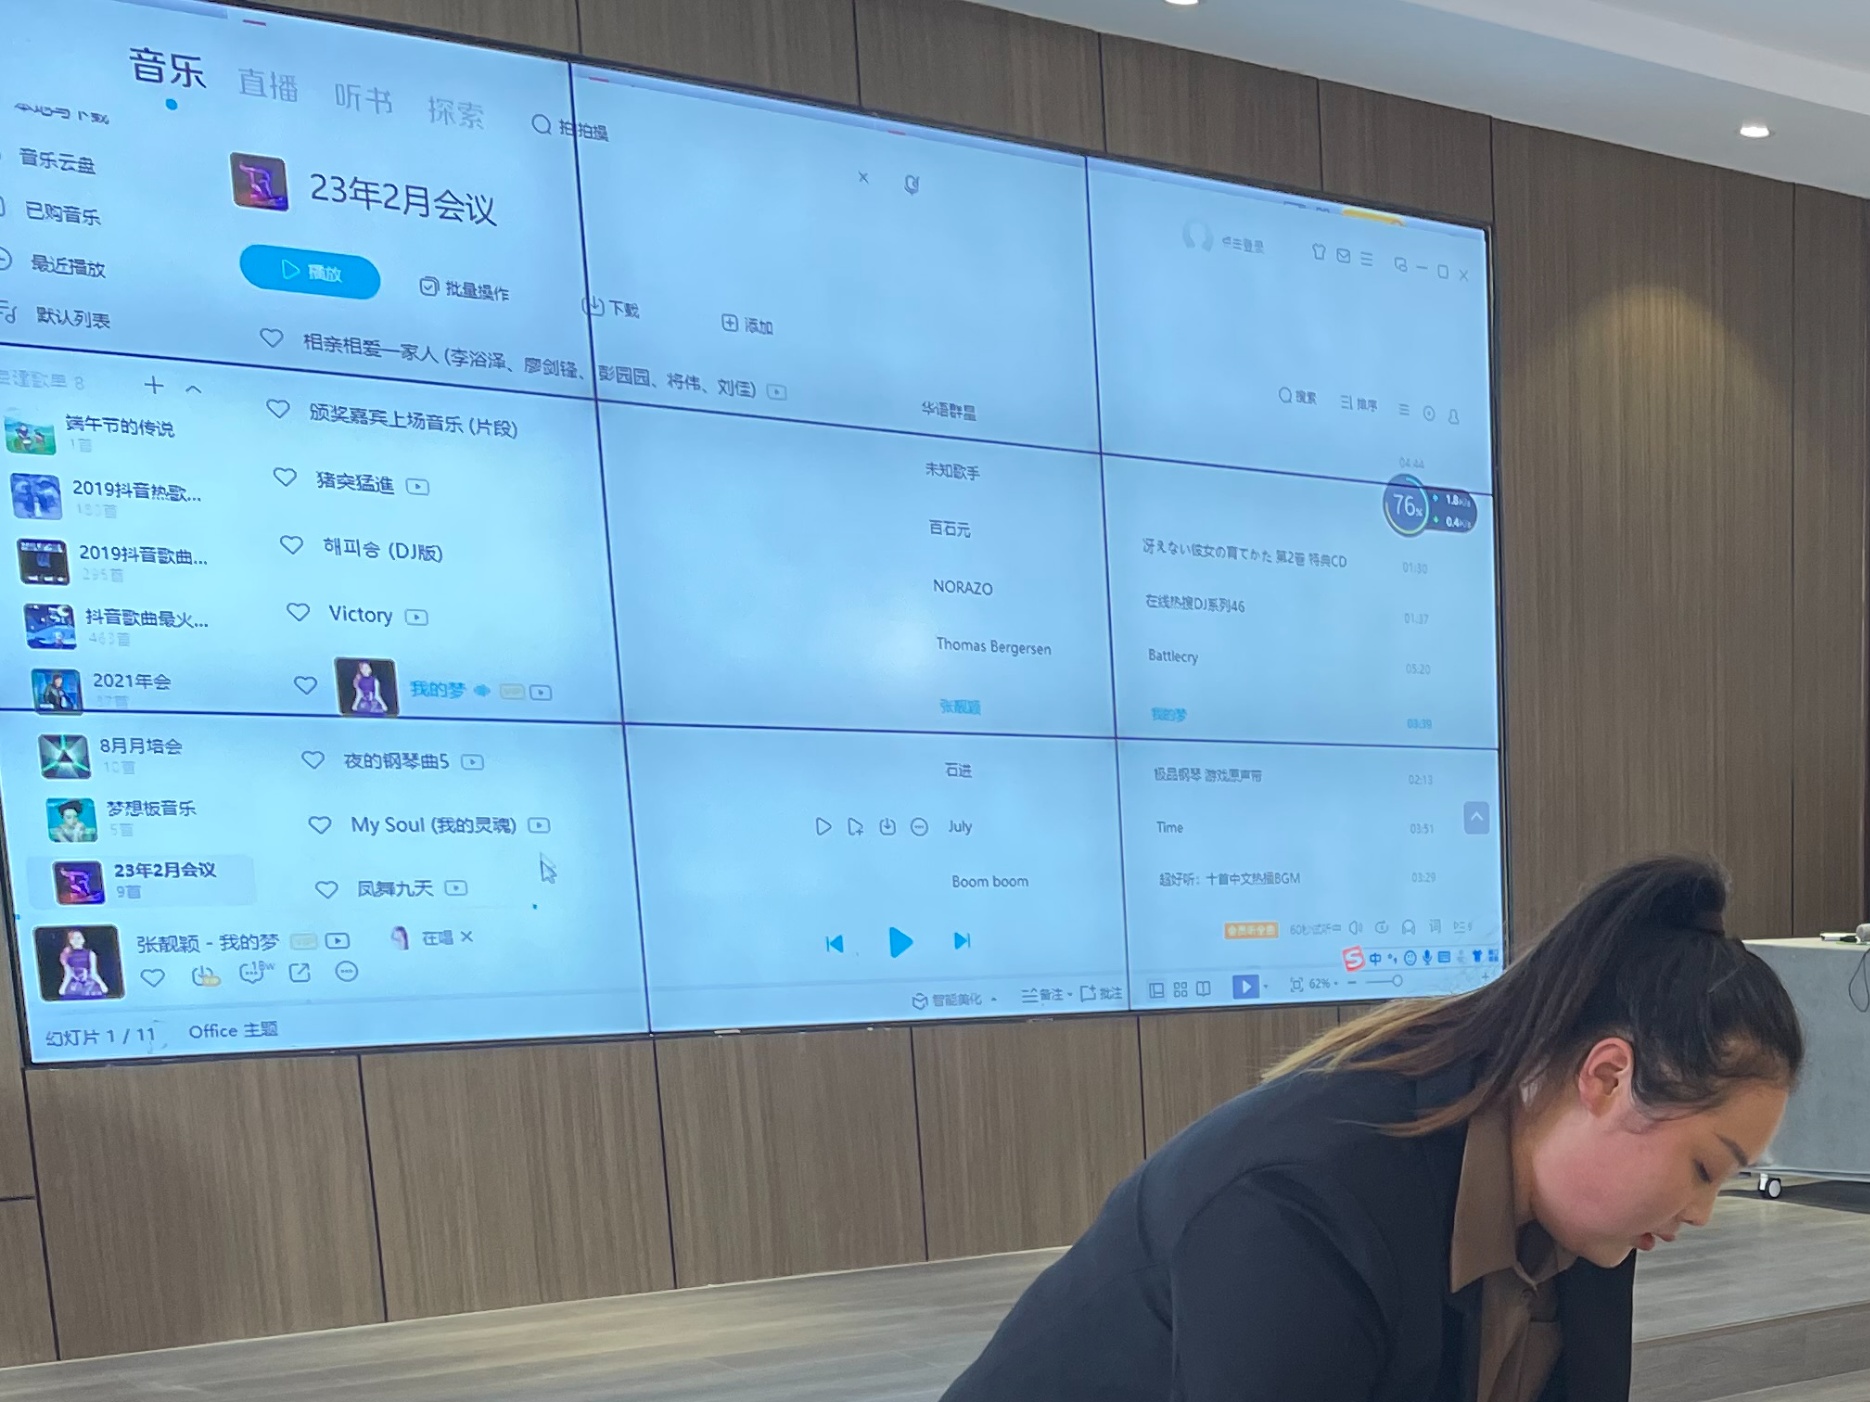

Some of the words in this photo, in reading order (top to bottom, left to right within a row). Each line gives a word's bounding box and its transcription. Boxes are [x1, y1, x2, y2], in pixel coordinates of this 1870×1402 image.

[129, 46, 206, 89] 音乐
[238, 68, 298, 103] 直播
[335, 83, 393, 114] 听书
[428, 96, 485, 130] 探索
[19, 148, 96, 175] 音乐云盘
[310, 173, 497, 226] 23年2月会议
[26, 201, 101, 226] 已购音乐
[31, 254, 106, 278] 最近播放
[308, 264, 342, 283] 播放
[446, 280, 510, 301] 批量操作
[36, 306, 111, 329] 默认列表
[609, 300, 640, 319] 下载
[303, 333, 440, 364] 相亲相爱一家人
[65, 413, 176, 438] 端午节的传说
[310, 403, 465, 434] 颁奖嘉宾上场音乐
[468, 417, 518, 439] (片段)
[925, 461, 981, 481] 未知歌手
[928, 519, 971, 538] 百石元
[323, 537, 380, 559] 해피송
[933, 578, 993, 596] NORAZO
[329, 604, 393, 627] Victory
[936, 636, 987, 654] Thomas
[990, 639, 1052, 658] Bergersen
[1148, 648, 1199, 667] Battlecry
[93, 672, 171, 691] 2021年会
[410, 679, 467, 699] 我的梦
[100, 737, 183, 755] 8月月培会
[344, 751, 450, 770] 夜的钢琴曲5
[107, 800, 197, 817] 梦想板音乐
[351, 816, 380, 836] My
[385, 816, 425, 833] Soul
[431, 816, 517, 835] (我的灵魂)
[949, 819, 973, 836] July
[1156, 820, 1184, 834] Time
[114, 861, 217, 878] 23年2月会议
[358, 879, 434, 898] 凤舞九天
[952, 875, 989, 888] Boom
[992, 874, 1029, 888] boom
[219, 933, 280, 952] 我的梦
[1309, 977, 1331, 989] 62%
[46, 1029, 99, 1047] 幻灯片
[107, 1029, 114, 1043] 1
[139, 1028, 154, 1042] 11
[189, 1022, 237, 1040] Office
[244, 1021, 279, 1038] 主题
